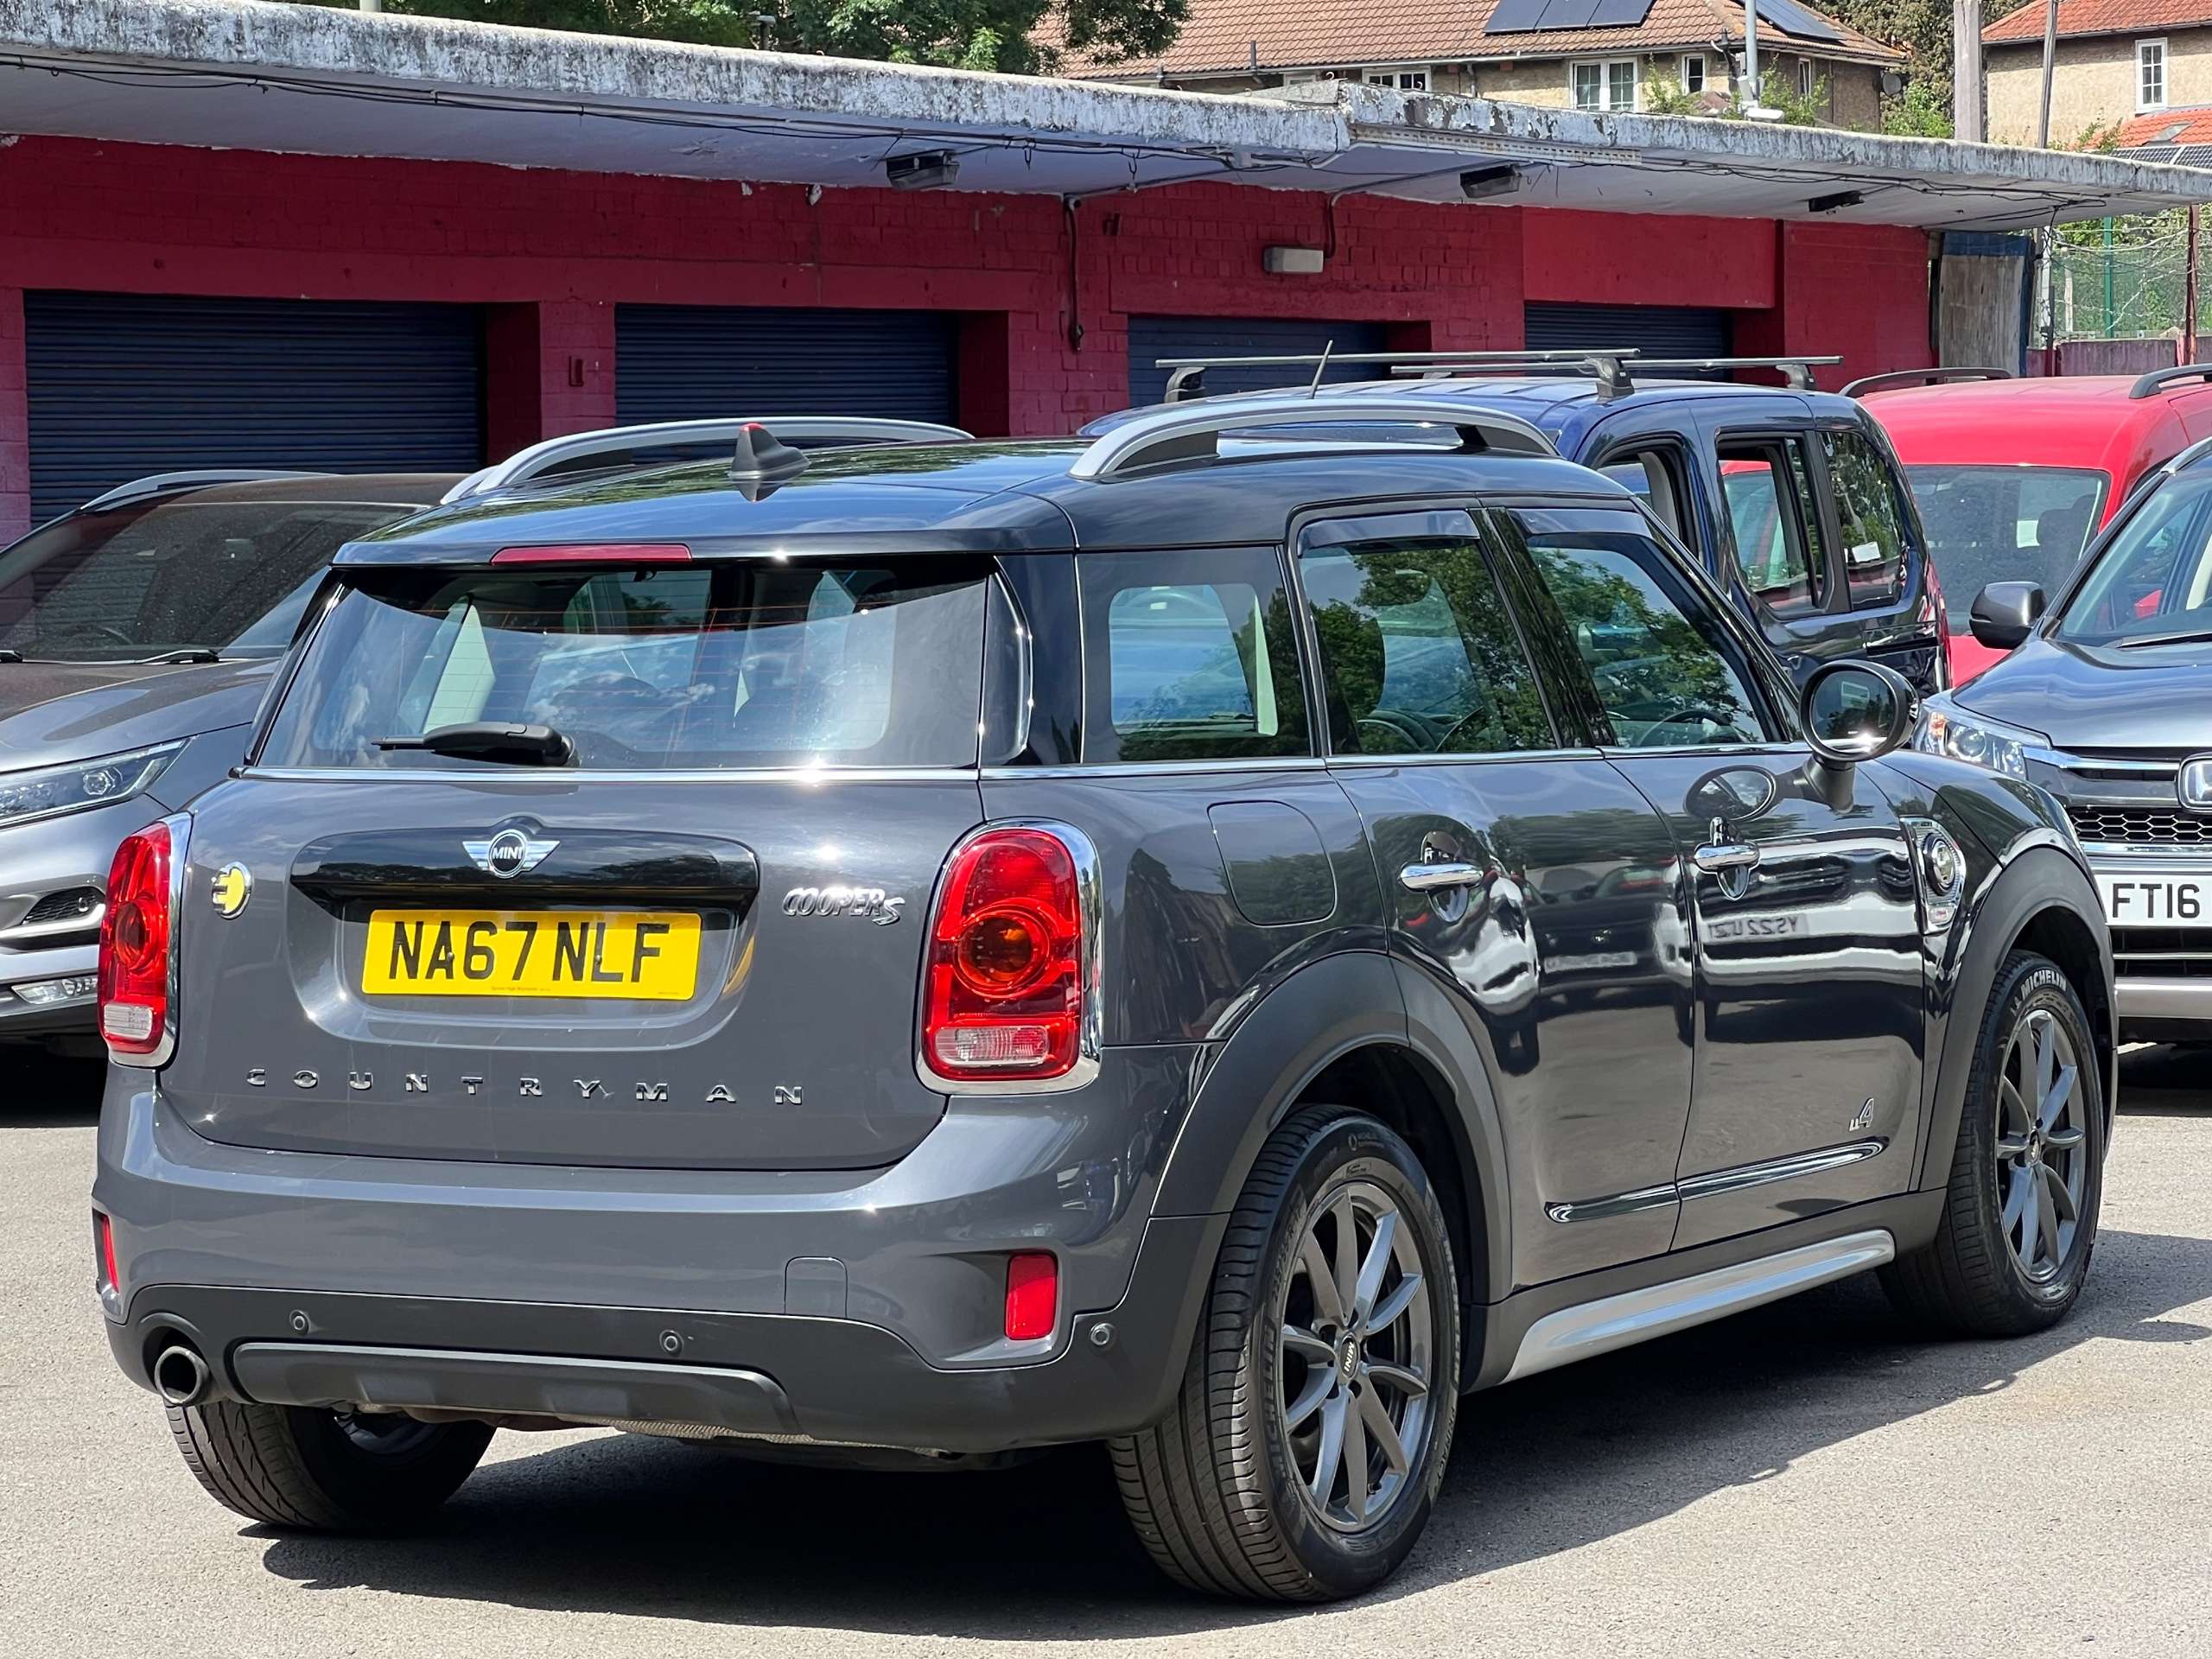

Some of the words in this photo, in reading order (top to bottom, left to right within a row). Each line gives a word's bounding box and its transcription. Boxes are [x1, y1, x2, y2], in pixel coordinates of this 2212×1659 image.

[493, 846, 524, 860] MINI
[2112, 882, 2201, 918] FT16
[388, 920, 538, 981] NA67
[551, 921, 671, 982] NLF
[2020, 969, 2067, 1001] MICHELIN
[246, 1068, 804, 1106] COUNTRYMAN
[1344, 1340, 1356, 1372] MINI
[1262, 1325, 1287, 1479] MICHELIN
